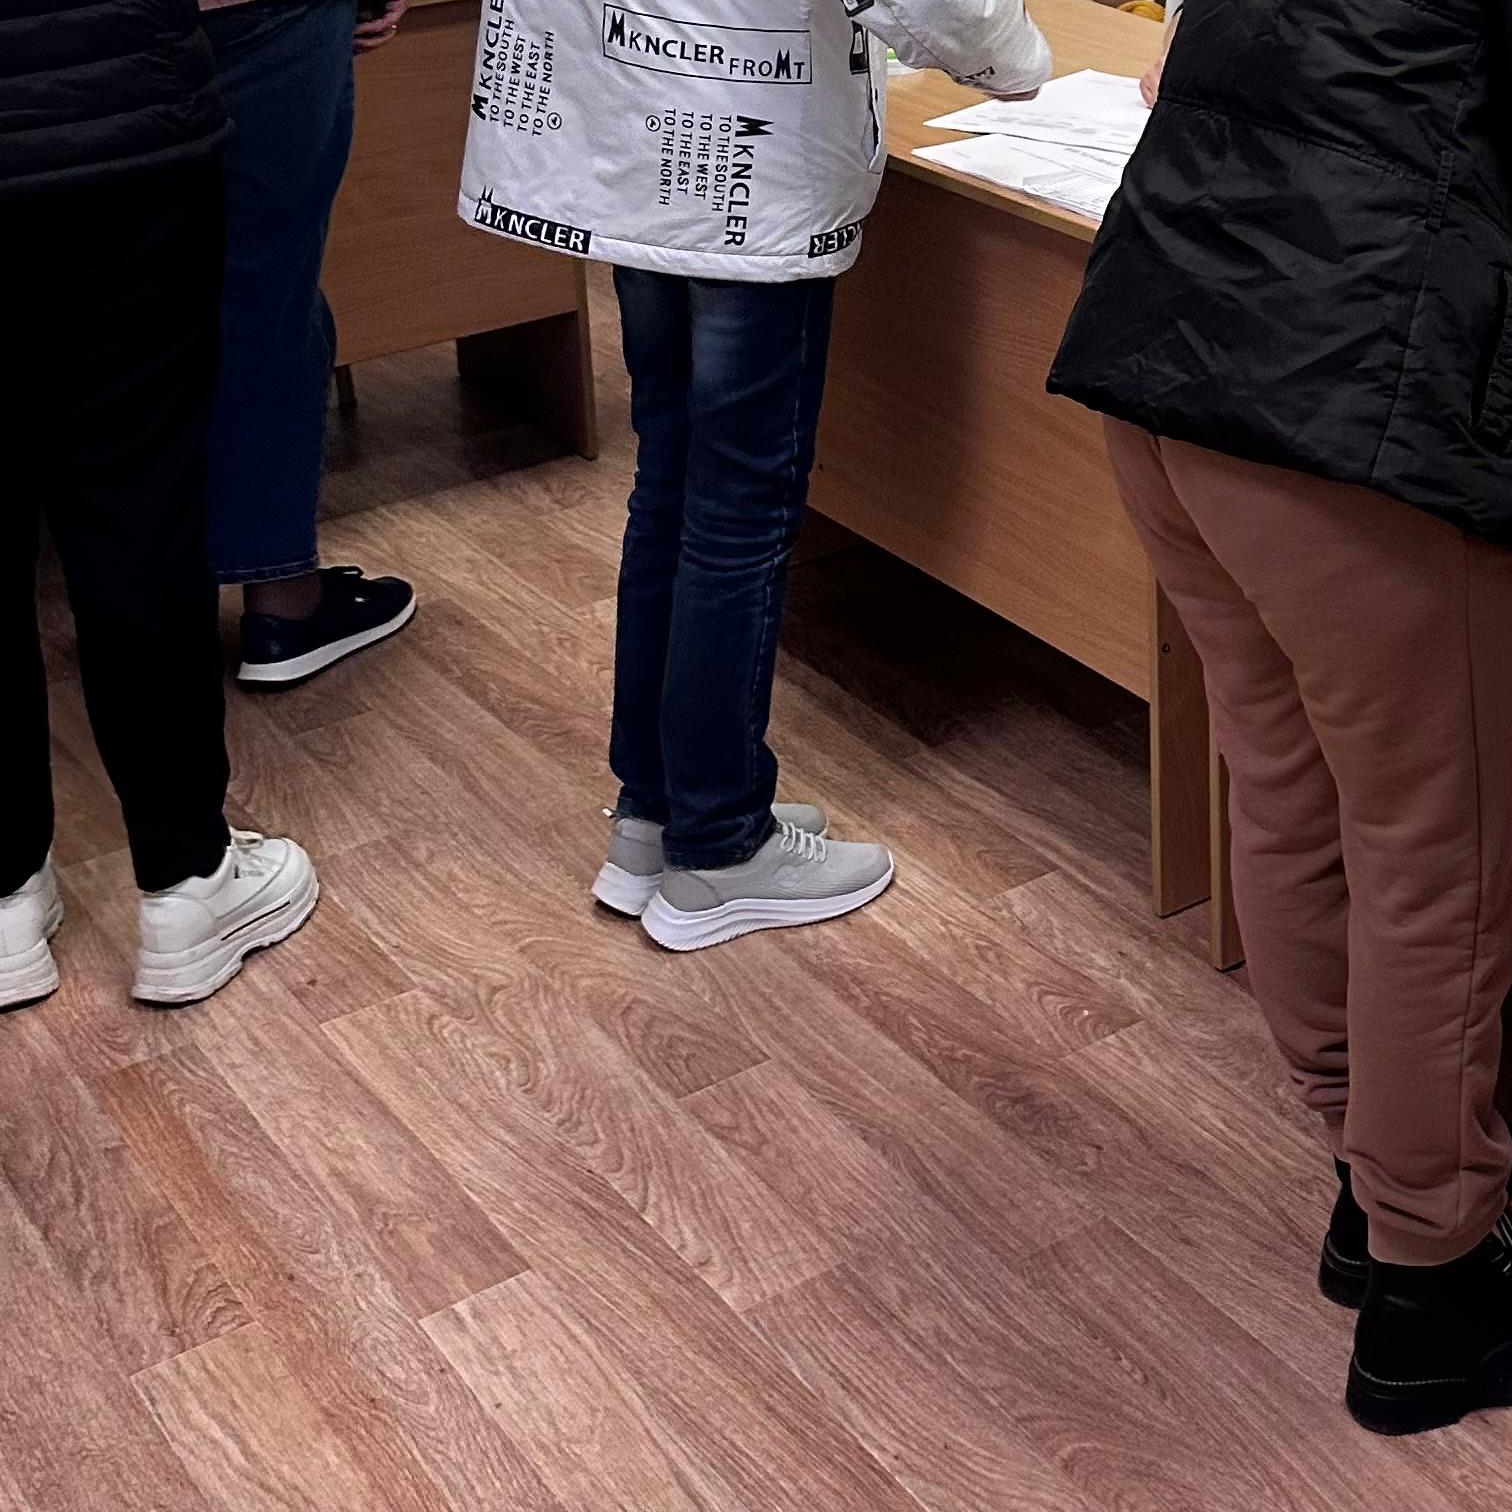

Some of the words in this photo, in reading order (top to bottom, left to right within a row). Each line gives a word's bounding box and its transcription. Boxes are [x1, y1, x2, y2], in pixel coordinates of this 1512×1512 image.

[497, 19, 515, 72] SOUTH
[607, 10, 725, 65] MKNCLER
[511, 34, 526, 75] WEST
[526, 41, 541, 80] EAST
[542, 31, 555, 83] NORTH
[492, 72, 504, 101] THE
[506, 77, 520, 106] THE
[522, 81, 536, 110] THE
[536, 86, 550, 114] THE
[490, 104, 500, 123] TO
[503, 109, 515, 128] TO
[517, 113, 529, 132] TO
[532, 118, 544, 137] TO
[664, 108, 676, 126] TO
[681, 111, 694, 129] TO
[700, 113, 713, 131] TO
[719, 115, 732, 133] TO
[661, 129, 675, 156] THE
[679, 132, 693, 159] THE
[697, 135, 711, 160] THE
[716, 136, 730, 163] THE
[658, 158, 672, 206] NORTH
[677, 160, 691, 195] EAST
[694, 163, 709, 200] WEST
[711, 163, 728, 212] SOUTH
[724, 115, 774, 246] MKNCLER
[475, 185, 586, 251] MKNCLER
